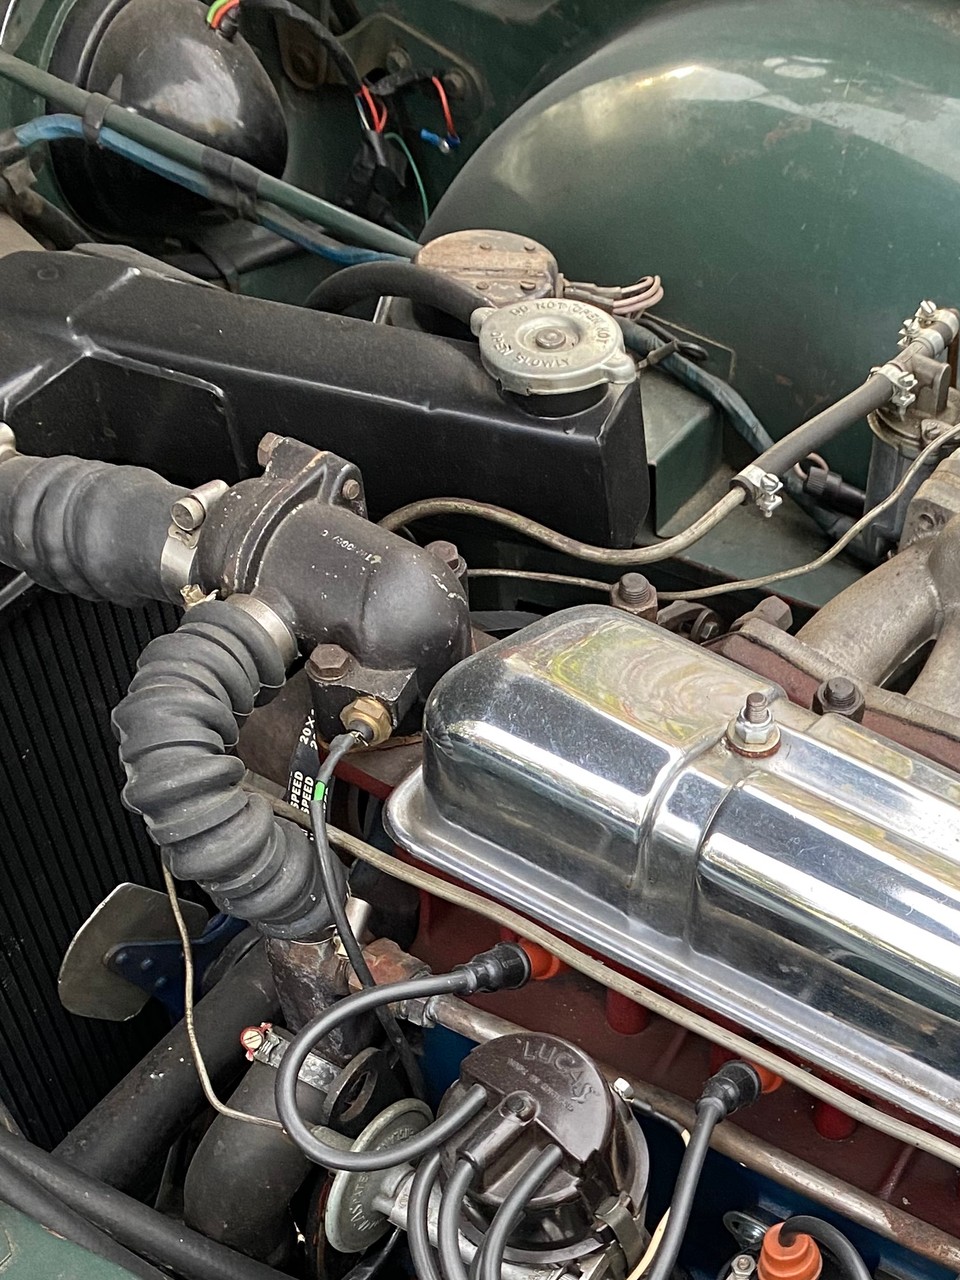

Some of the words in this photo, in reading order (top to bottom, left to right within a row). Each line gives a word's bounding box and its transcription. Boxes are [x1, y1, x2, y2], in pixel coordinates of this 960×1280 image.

[290, 770, 304, 810] SPEED
[300, 776, 315, 815] SPEED
[523, 1040, 593, 1105] LUCAS
